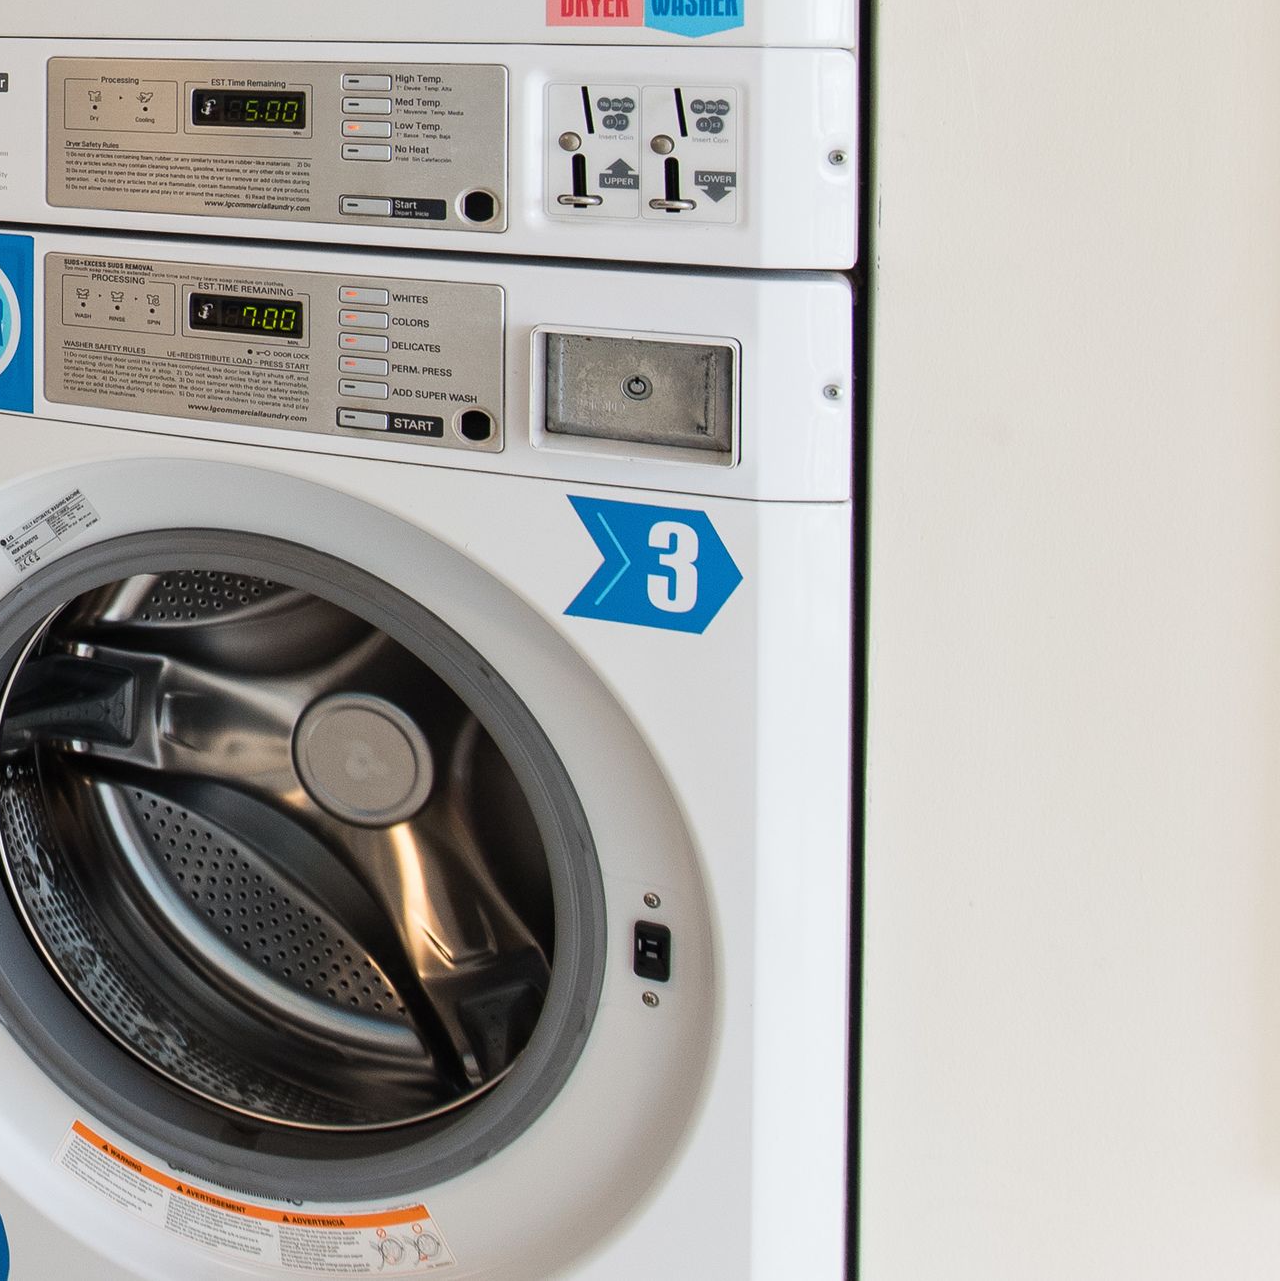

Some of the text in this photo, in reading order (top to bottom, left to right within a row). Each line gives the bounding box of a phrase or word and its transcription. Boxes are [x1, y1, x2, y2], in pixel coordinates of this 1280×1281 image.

[101, 76, 139, 85] Processing
[395, 74, 444, 84] High Temp.
[247, 80, 286, 89] Remaining
[395, 98, 443, 108] Med Temp.
[245, 100, 298, 123] 5.00
[395, 122, 442, 131] Low Temp.
[395, 145, 429, 154] No Heat
[604, 176, 634, 186] UPPER
[698, 174, 732, 184] LOWER
[395, 199, 417, 209] Start
[92, 274, 145, 285] PROCESSING
[241, 286, 293, 296] REMAINING
[392, 294, 428, 304] WHITES
[243, 306, 295, 330] 7.00
[392, 318, 429, 328] COLORS
[64, 340, 146, 354] WASHER SAFETY RULES
[392, 342, 440, 353] DELICATES
[392, 365, 452, 377] PERM. PRESS
[392, 388, 477, 403] ADD SUPER WASH
[394, 418, 434, 432] START
[647, 520, 698, 613] 3
[110, 1149, 142, 1172] WARNING
[186, 1188, 246, 1214] AVERTISSEMENT
[292, 1217, 345, 1227] ADVERTENCIA
